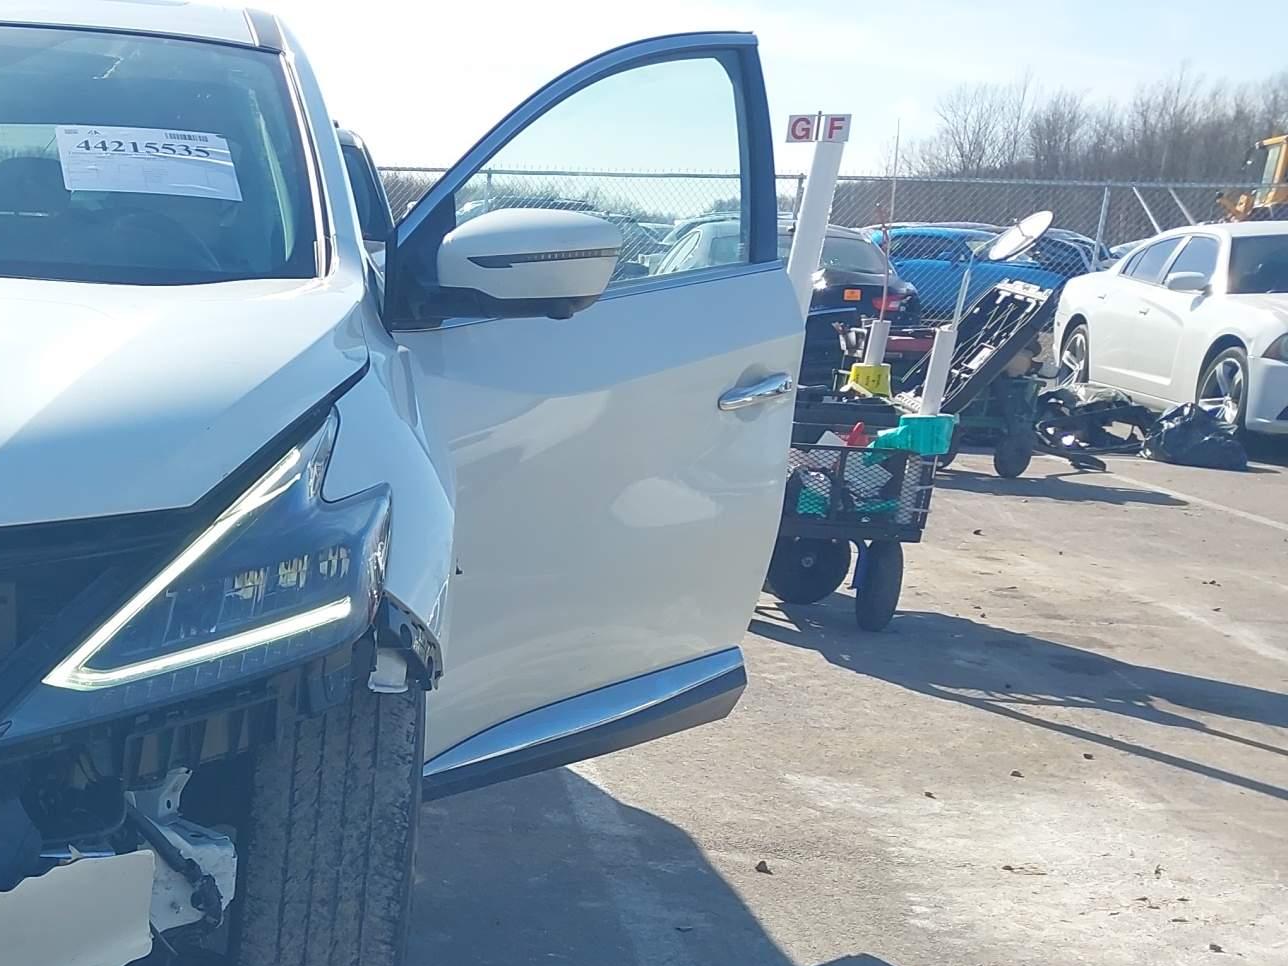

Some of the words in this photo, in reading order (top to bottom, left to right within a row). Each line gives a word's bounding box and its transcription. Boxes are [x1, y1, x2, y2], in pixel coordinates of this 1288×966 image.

[791, 117, 811, 140] G
[828, 117, 845, 139] F
[76, 139, 210, 158] 44215535
